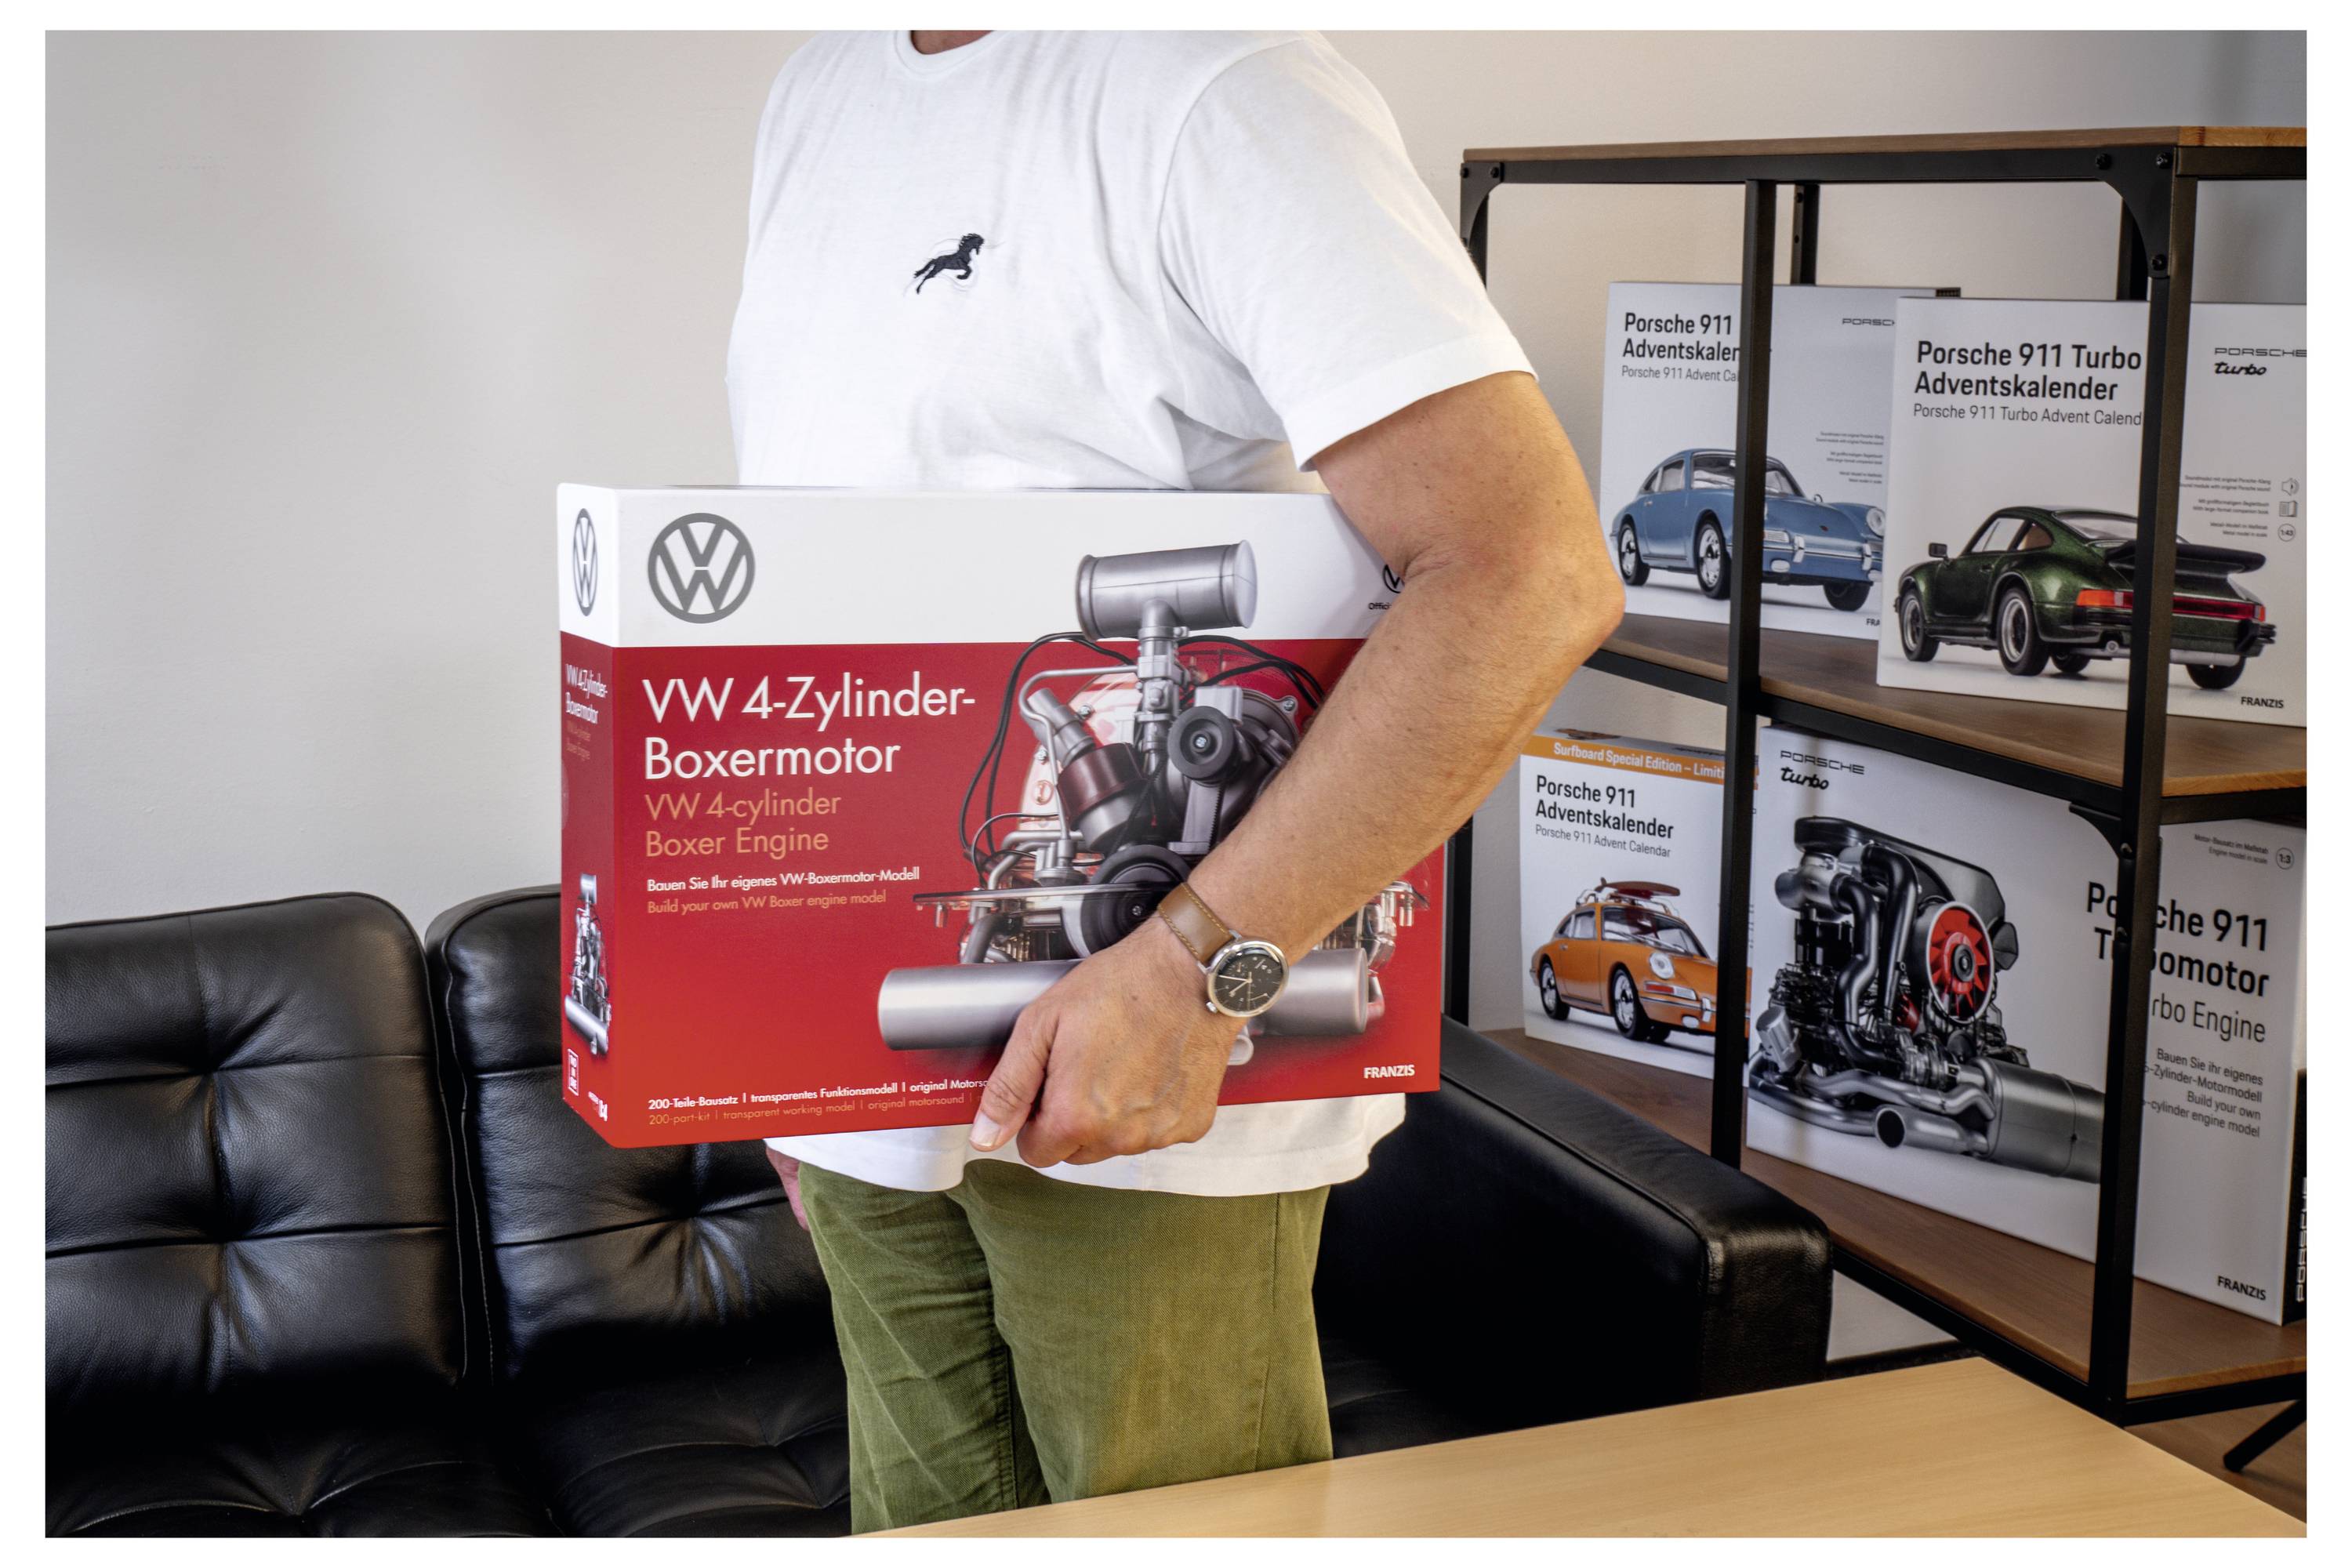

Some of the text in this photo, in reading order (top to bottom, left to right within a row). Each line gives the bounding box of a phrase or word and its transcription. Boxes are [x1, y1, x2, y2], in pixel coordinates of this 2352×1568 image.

[1624, 312, 1732, 335] Porsche 911
[1842, 318, 1895, 326] PORSC
[1917, 339, 2142, 371] Porsche 911 Turbo
[2214, 347, 2307, 358] PORSCHE
[1621, 365, 1661, 379] Porsche
[1663, 367, 1682, 380] 911
[1686, 368, 1720, 382] Advent
[2214, 361, 2267, 376] turbo
[1914, 370, 2118, 401] Adventskalender
[1913, 404, 2142, 426] Porsche 911 Turbo Advent Calend
[642, 671, 975, 731] VW 4-Zylinder-
[2241, 695, 2285, 709] FRANZIS
[645, 737, 901, 779] Boxermotor
[1553, 741, 1605, 763] Surfboard
[1606, 746, 1644, 768] Special
[1646, 752, 1682, 773] Edition
[1780, 750, 1865, 775] PORSCHE
[1536, 775, 1636, 808] Porsche 911
[1780, 766, 1829, 790] turbo
[645, 788, 842, 826] VW 4-cylinder
[1535, 799, 1675, 840] Adventskalender
[645, 826, 829, 859] Boxer Engine
[1535, 824, 1671, 858] Porsche 911 Advent Calendar
[647, 866, 920, 891] Bauen Sie Ihr eigenes VW-Boxermotor-Modell
[648, 889, 886, 916] Build your own VW Boxer engine model
[2087, 881, 2267, 951] Poche 911
[2094, 927, 2270, 997] Tomotor
[2151, 993, 2266, 1042] rbo Engine
[1363, 1064, 1415, 1079] FRANZIS
[2157, 1048, 2263, 1086] Bauen Sie ihr eigenes
[648, 1096, 739, 1110] 200-Teile-Bausatz
[750, 1091, 818, 1105] transparentes
[820, 1081, 898, 1098] Funktionsmodell
[909, 1079, 948, 1094] original
[648, 1093, 964, 1126] 200-part-kit transparent working model original motorsound
[2187, 1091, 2260, 1120] Build your own
[2191, 1111, 2225, 1127] engine
[2228, 1122, 2260, 1137] model
[2217, 1276, 2267, 1301] FRANZIS
